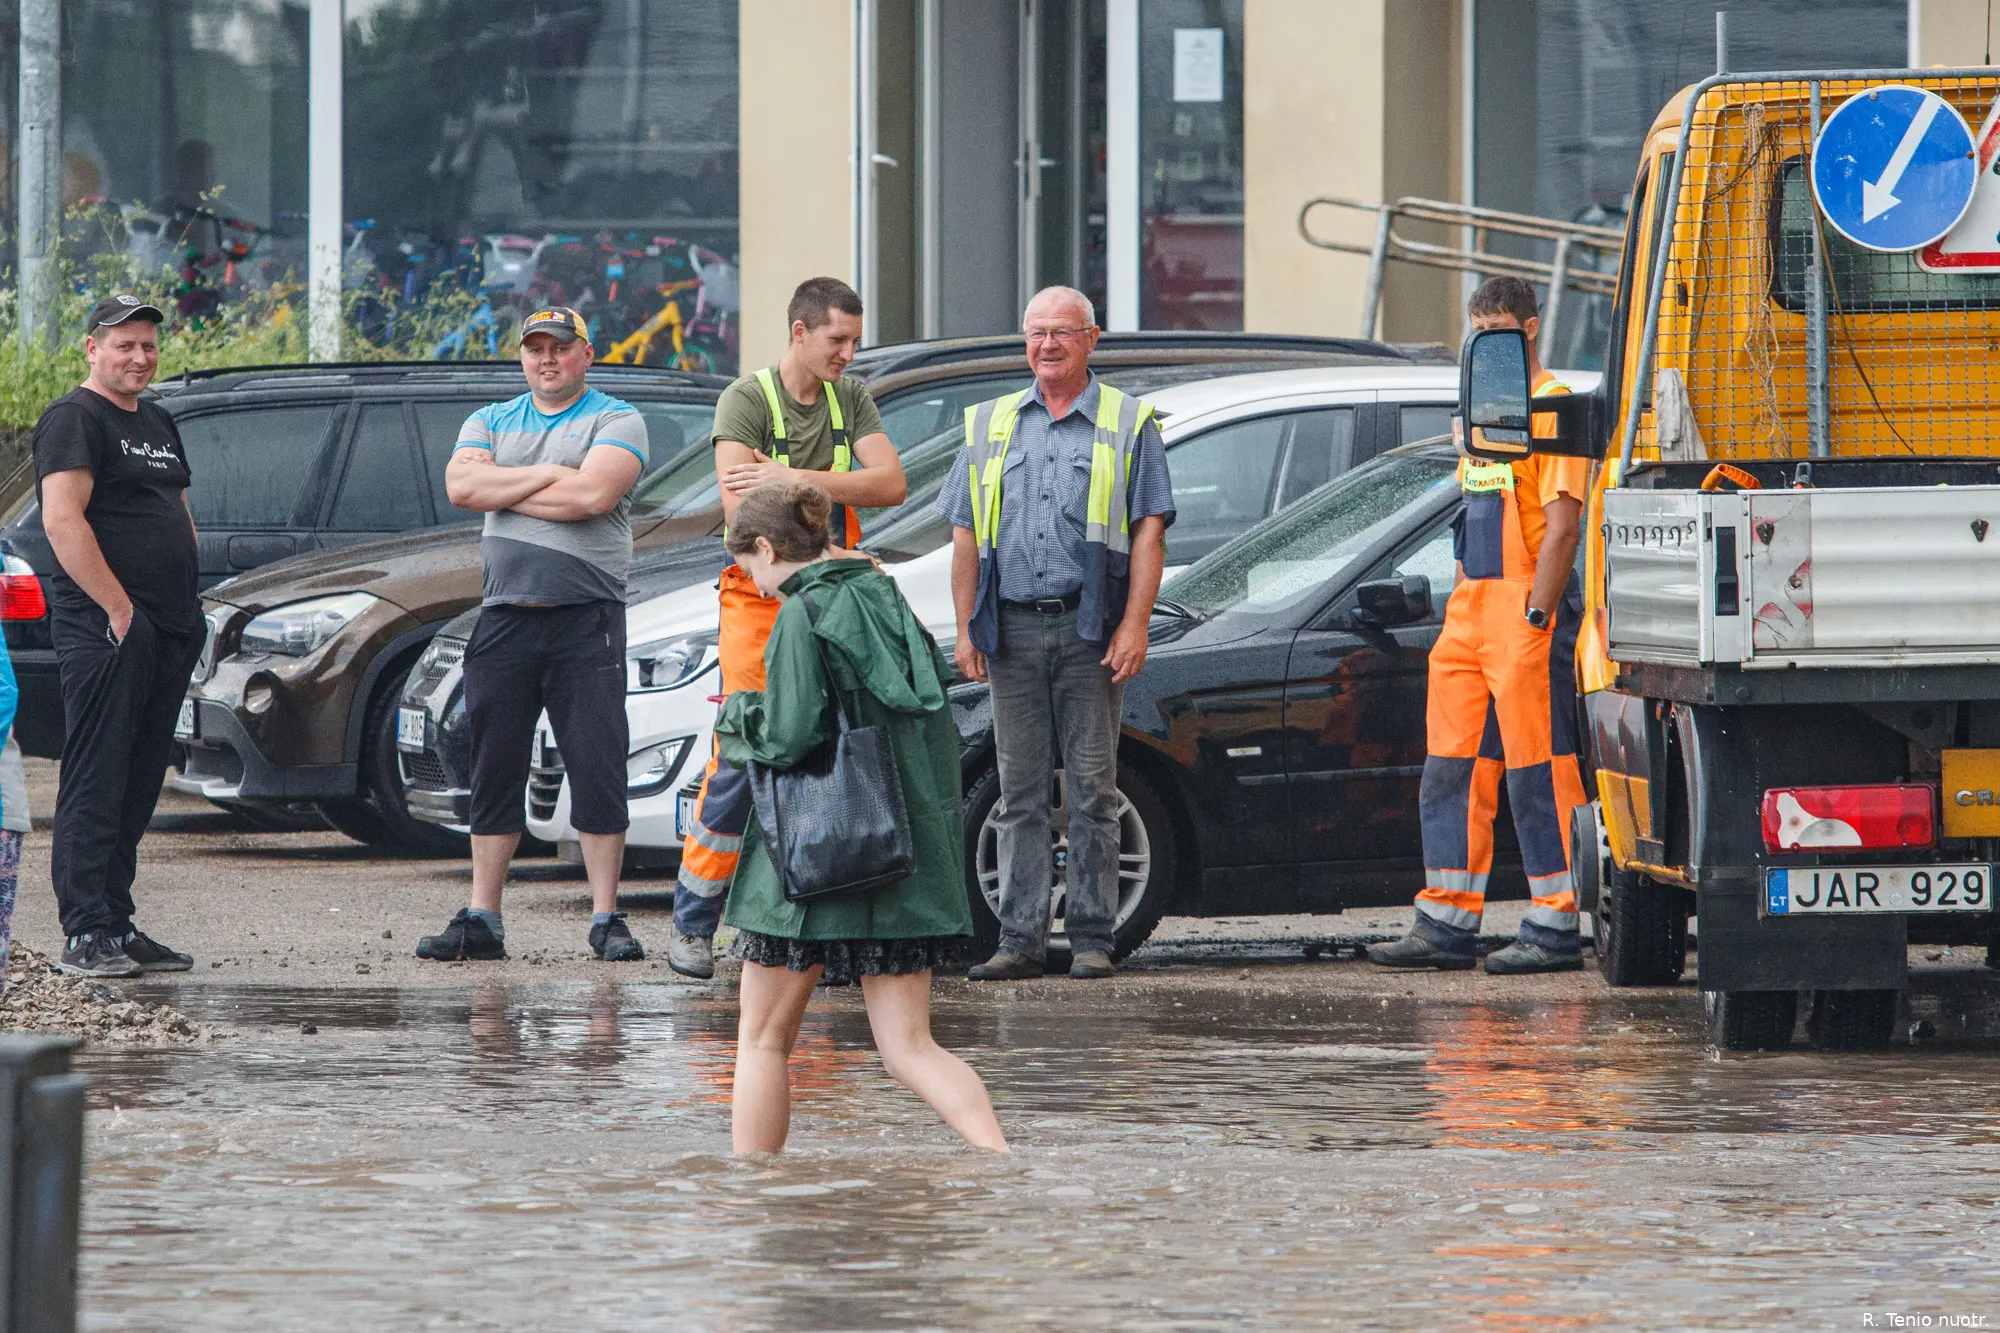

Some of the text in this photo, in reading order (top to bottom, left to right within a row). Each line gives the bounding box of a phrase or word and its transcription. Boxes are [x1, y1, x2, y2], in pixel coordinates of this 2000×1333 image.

[147, 460, 168, 469] PARIS
[1955, 790, 2000, 807] CR
[1770, 871, 1984, 907] LT JAR 929
